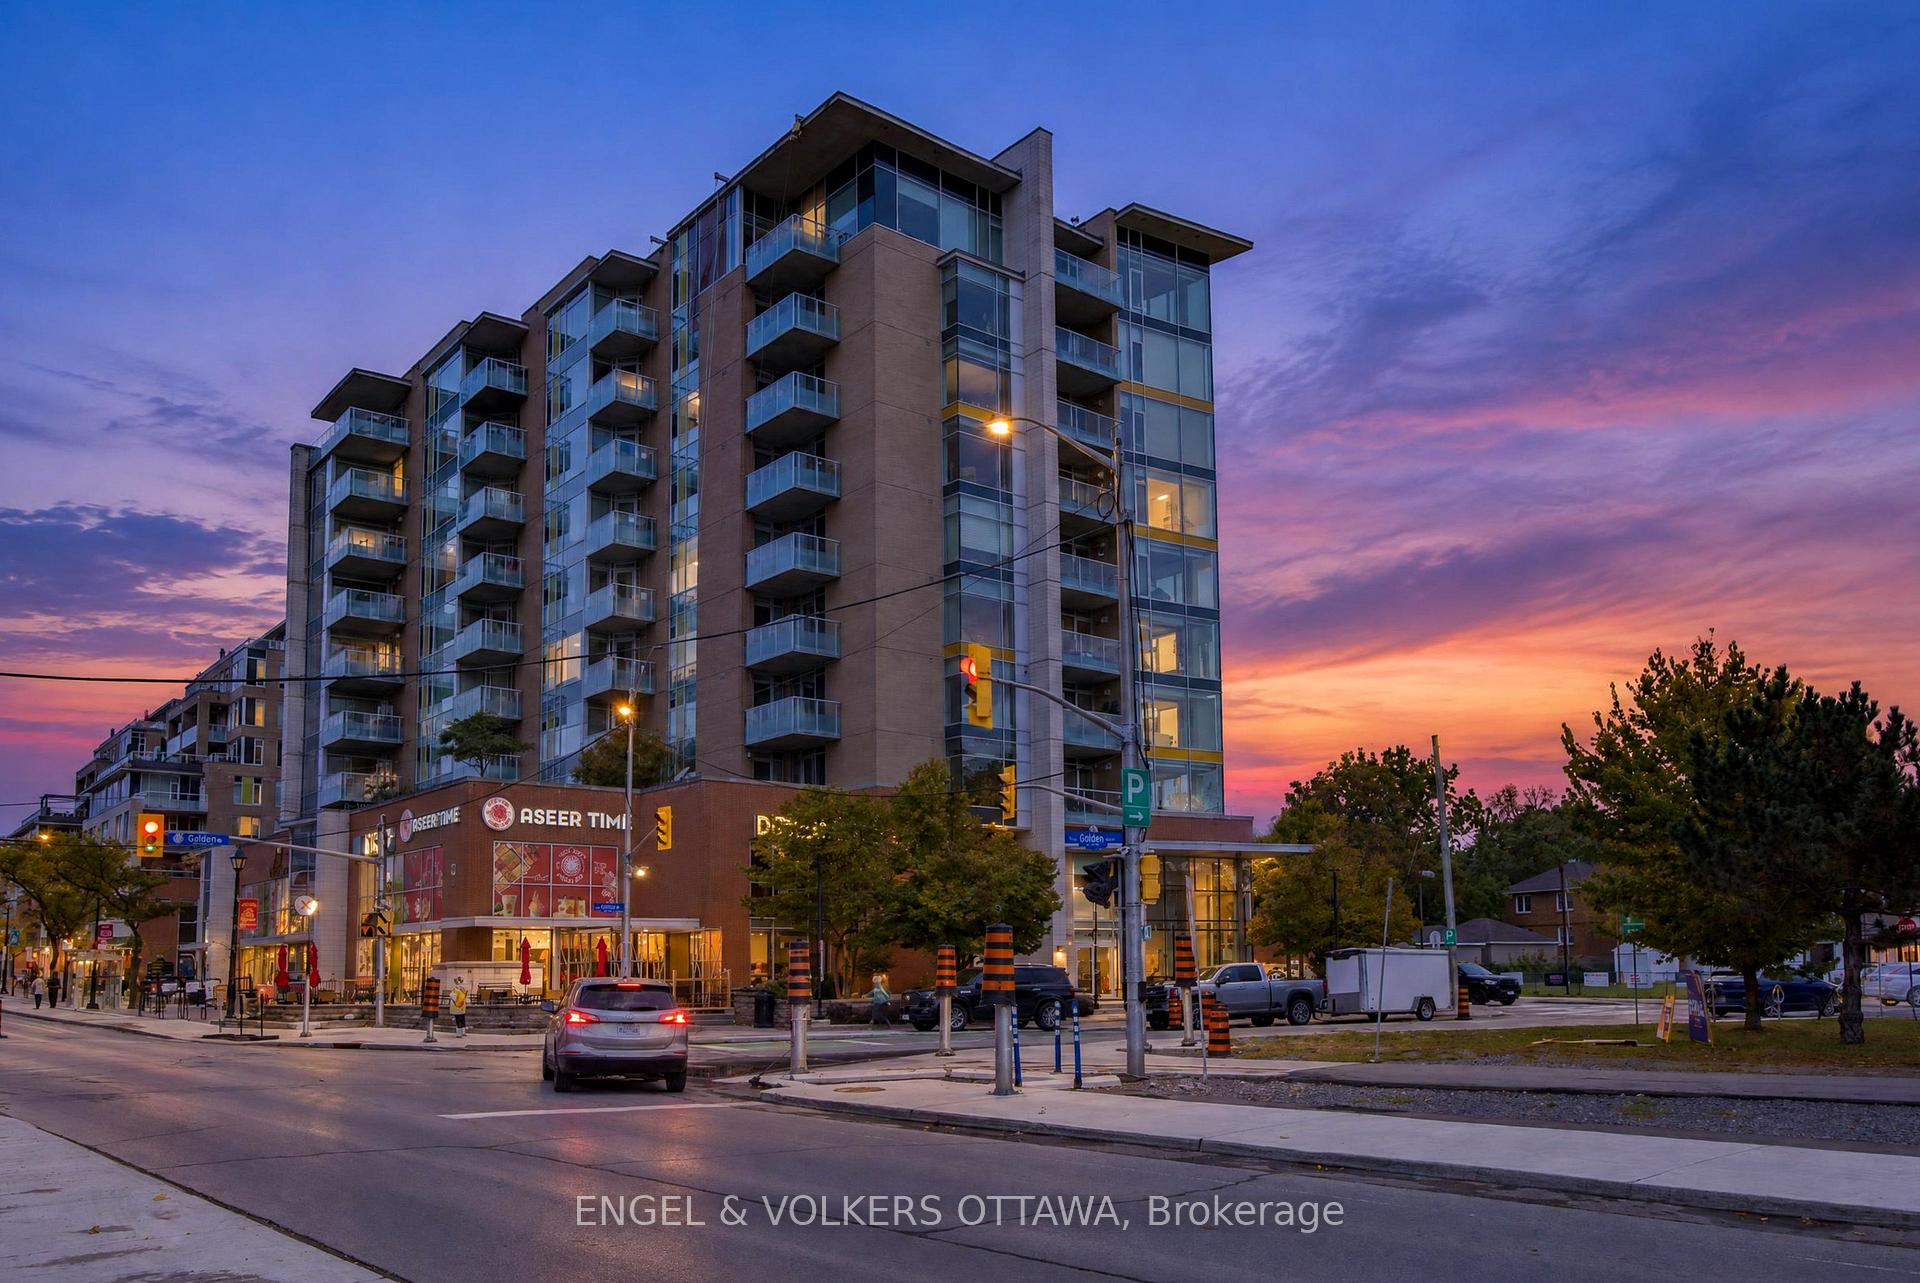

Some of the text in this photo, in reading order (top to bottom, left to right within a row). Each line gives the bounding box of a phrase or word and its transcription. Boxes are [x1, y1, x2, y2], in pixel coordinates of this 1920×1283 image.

[1127, 773, 1144, 803] P
[413, 814, 439, 832] ASEER
[520, 808, 582, 827] ASEER
[188, 834, 217, 843] Golden
[1080, 833, 1104, 843] Golden
[1446, 930, 1453, 940] P
